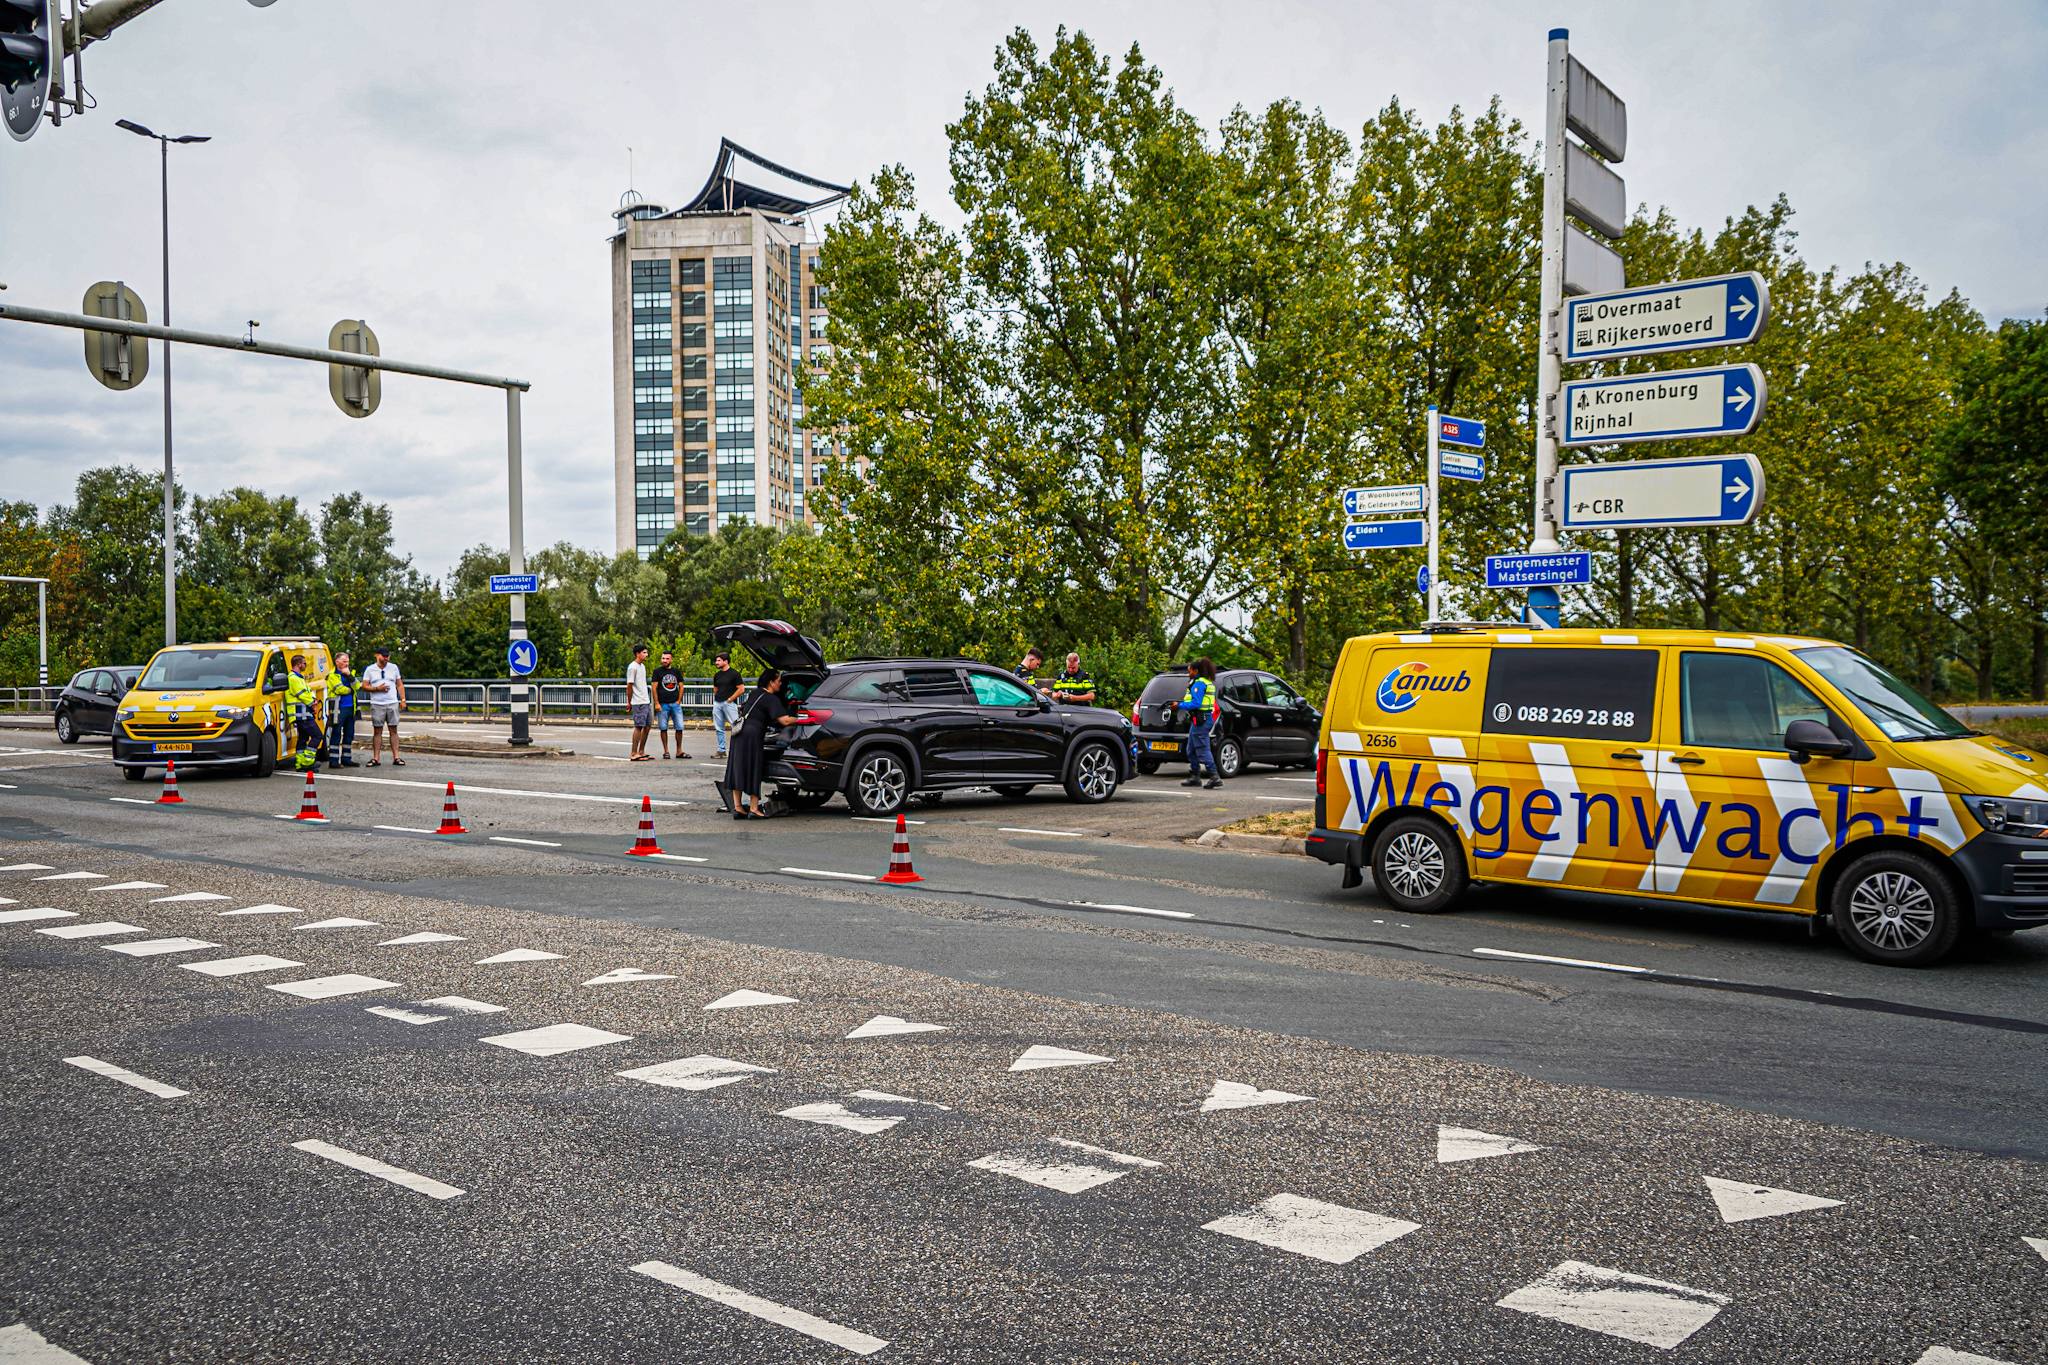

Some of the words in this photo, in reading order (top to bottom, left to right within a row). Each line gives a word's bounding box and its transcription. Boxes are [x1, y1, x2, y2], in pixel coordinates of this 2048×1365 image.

[1597, 295, 1682, 319] Overmaat
[1597, 315, 1713, 346] Rijkerswoerd
[1595, 384, 1698, 405] Kronenburg
[1443, 424, 1459, 435] A325
[1574, 412, 1633, 434] Rijnhal
[1367, 489, 1420, 499] Woonboulevard
[1592, 498, 1624, 514] CBR
[1355, 526, 1378, 535] Elden
[1494, 556, 1581, 570] Burgemeester
[1498, 569, 1578, 582] Matsersingel
[1396, 670, 1471, 692] anwb
[1517, 706, 1548, 722] 088
[1551, 708, 1584, 725] 269
[1586, 709, 1609, 726] 28
[1612, 711, 1635, 728] 88
[1366, 733, 1398, 748] 2636
[1349, 759, 1940, 865] Wegenwacht
